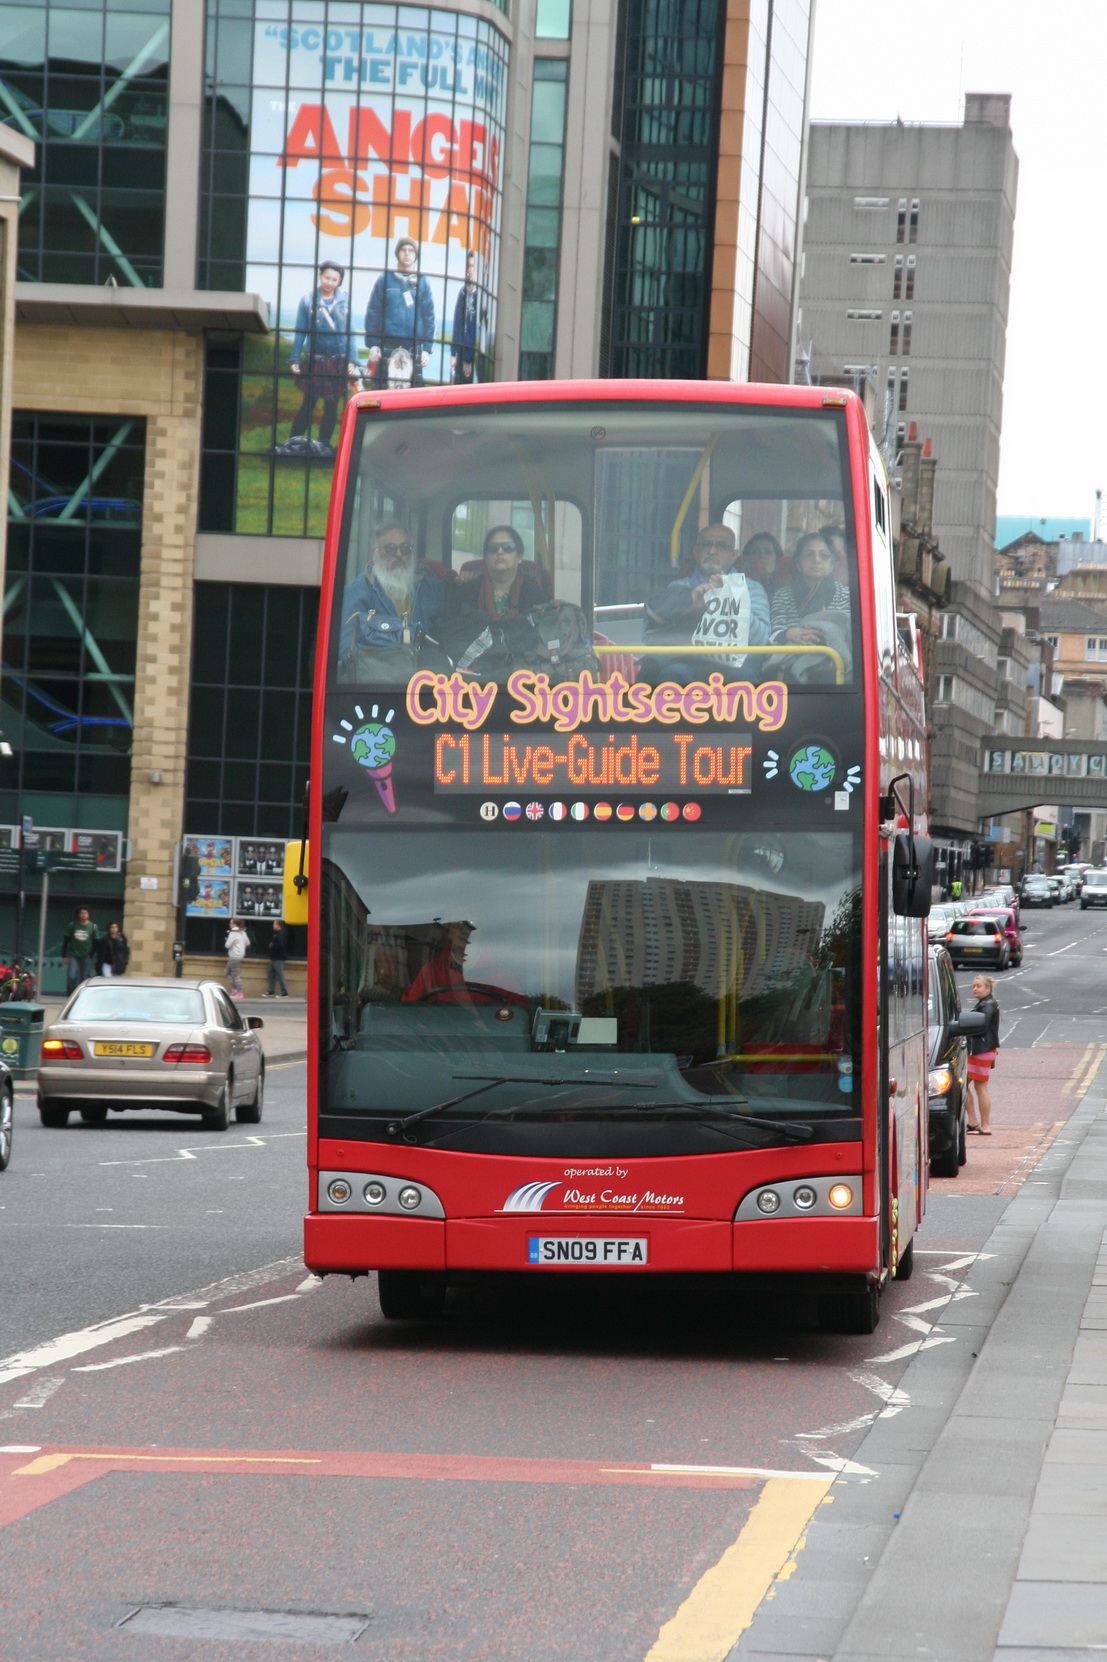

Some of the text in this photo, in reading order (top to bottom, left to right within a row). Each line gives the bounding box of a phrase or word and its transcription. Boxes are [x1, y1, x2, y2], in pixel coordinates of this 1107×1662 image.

[319, 55, 392, 84] THE
[397, 60, 468, 94] FULL
[406, 669, 788, 732] City Sightseeing
[436, 733, 752, 786] C1 Live-Guide Tour
[101, 1044, 146, 1055] Y514 FLS
[563, 1166, 629, 1179] operated by
[563, 1189, 684, 1210] West Coast Motors
[543, 1241, 643, 1261] SN09 FFA
